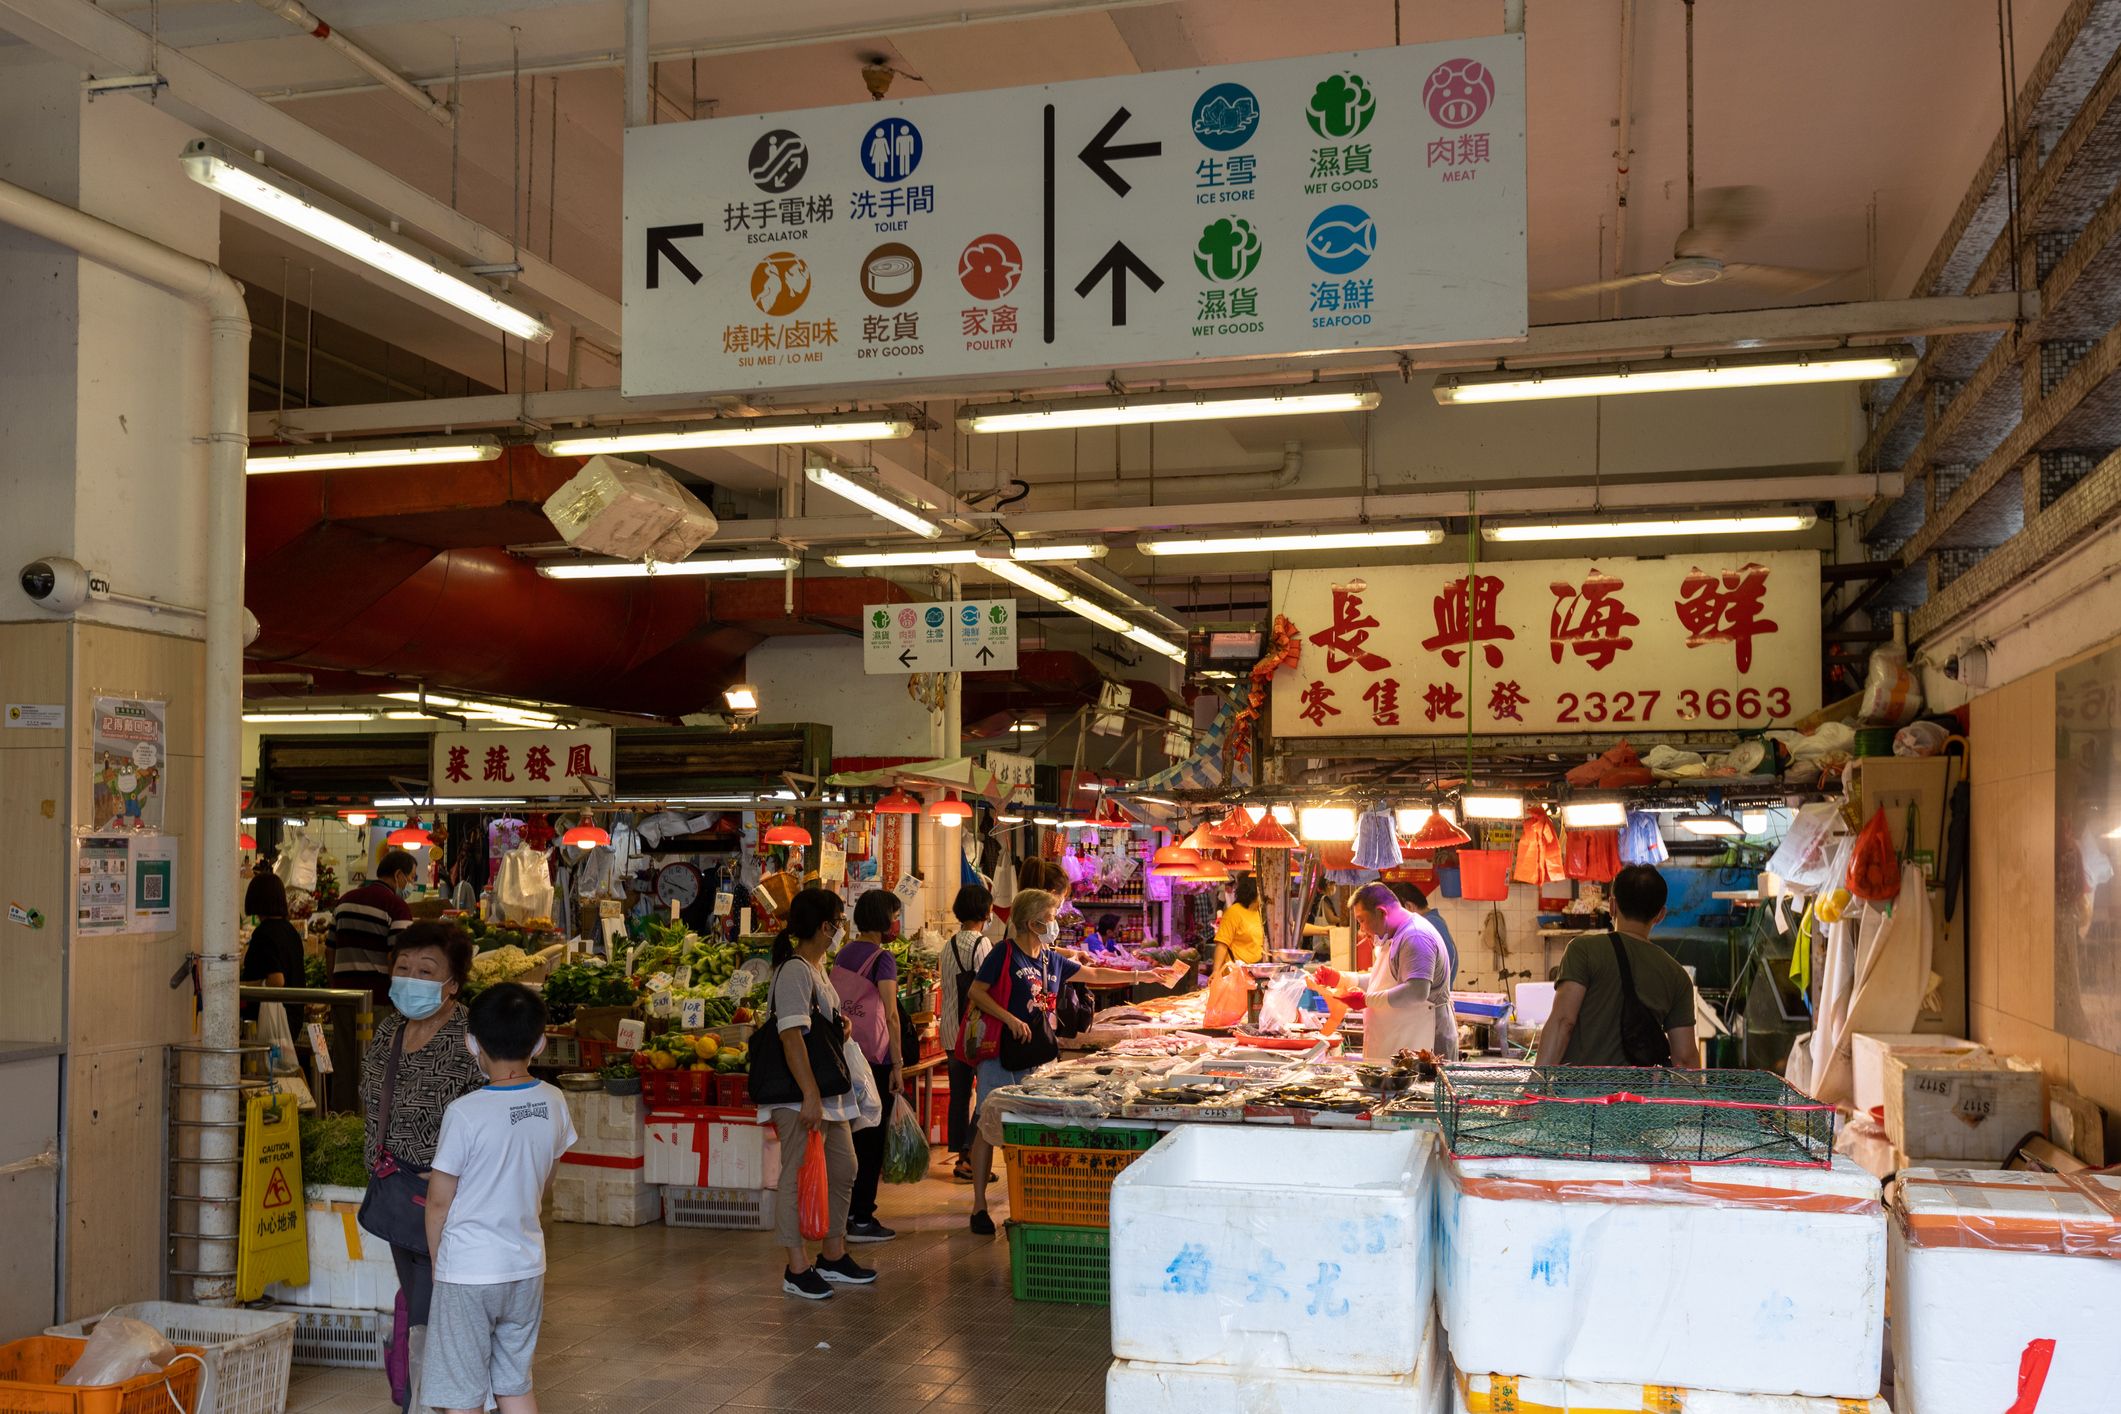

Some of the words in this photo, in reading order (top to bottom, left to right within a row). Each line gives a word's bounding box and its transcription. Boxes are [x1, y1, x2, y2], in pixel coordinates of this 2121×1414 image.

[1426, 132, 1490, 169] 肉類
[1309, 143, 1372, 179] 濕貨
[1195, 154, 1257, 188] 生雪
[1442, 169, 1476, 183] MEAT
[1304, 181, 1328, 195] WET
[1331, 178, 1378, 193] GOODS
[849, 185, 934, 220] 洗手間
[1196, 191, 1216, 205] ICE
[1219, 189, 1255, 204] STORE
[724, 194, 834, 232] 扶手電梯
[874, 220, 908, 233] TOILET
[747, 229, 808, 244] ESCALATOR
[1309, 278, 1374, 313] 海鮮
[1197, 287, 1258, 321] 濕貨
[862, 312, 919, 343] 乾貨
[960, 304, 1019, 337] 家禽
[1312, 314, 1371, 328] SEAFOOD
[1192, 323, 1215, 337] WET
[1218, 321, 1264, 336] GOODS
[857, 346, 879, 359] DRY
[881, 344, 924, 358] GOODS
[966, 338, 1014, 352] POULTRY
[738, 356, 755, 368] SIU
[757, 355, 776, 367] MEI
[787, 353, 801, 365] LO
[803, 352, 823, 364] MEI
[90, 578, 110, 593] CCTV
[1309, 562, 1778, 674] 長興海鮮
[1299, 678, 1530, 728] 零售批發
[1556, 690, 1661, 724] 2327
[1676, 686, 1792, 721] 3663
[1920, 1078, 1946, 1093] S117
[1963, 1100, 1990, 1113] S117
[262, 1142, 290, 1154] CAUTION
[259, 1155, 272, 1164] WET
[273, 1151, 294, 1163] FLOOR
[257, 1212, 297, 1237] 小心地滑
